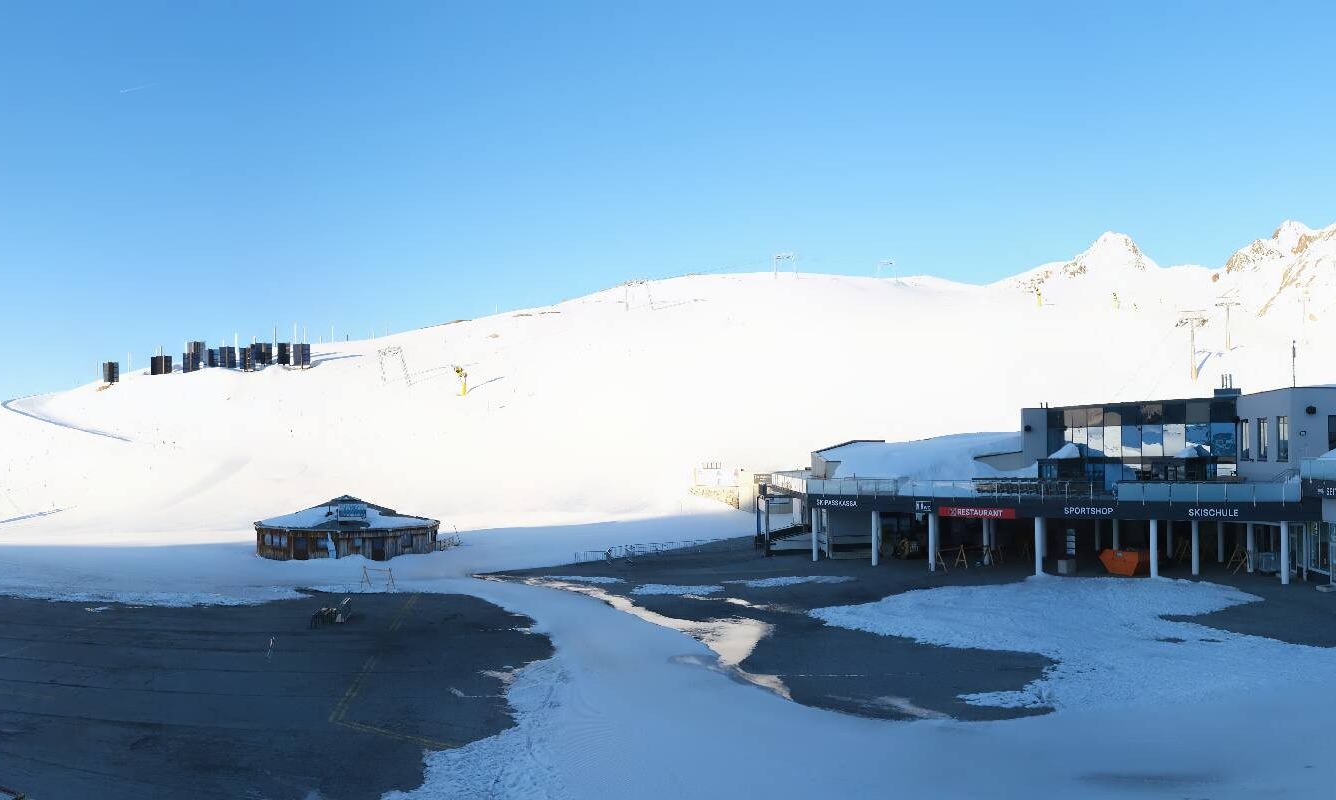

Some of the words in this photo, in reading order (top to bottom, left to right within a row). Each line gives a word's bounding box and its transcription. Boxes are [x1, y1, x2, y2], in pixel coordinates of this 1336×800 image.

[957, 508, 1004, 517] RESTAURANT
[1064, 507, 1114, 515] SPORTSHOP
[1188, 508, 1239, 517] SKISCHULE
